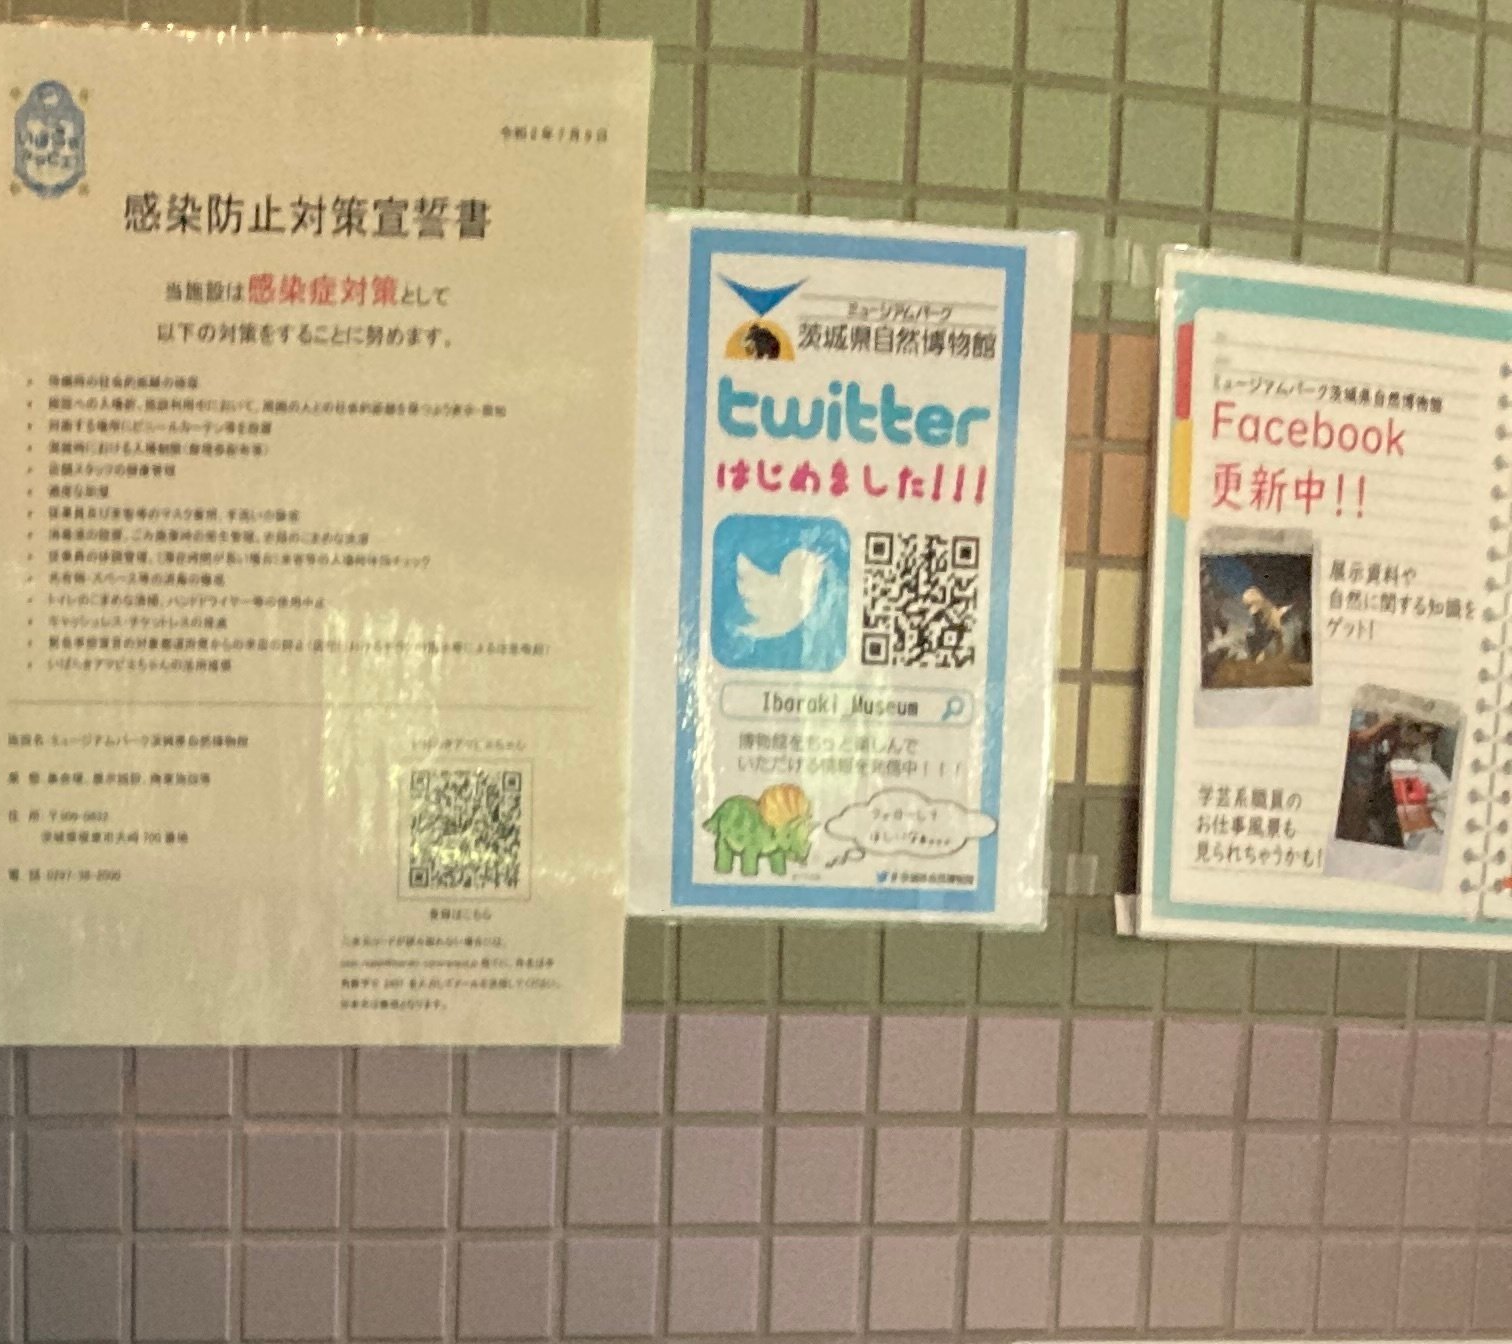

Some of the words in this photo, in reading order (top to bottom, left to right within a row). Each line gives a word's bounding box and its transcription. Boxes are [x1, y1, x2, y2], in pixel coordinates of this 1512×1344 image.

[123, 193, 491, 240] 感染防止対策宣誓書
[798, 322, 996, 359] 茨城県自然博物館
[717, 375, 991, 447] twitter
[1211, 400, 1406, 457] Facebook
[1210, 462, 1367, 519] 更新中!!
